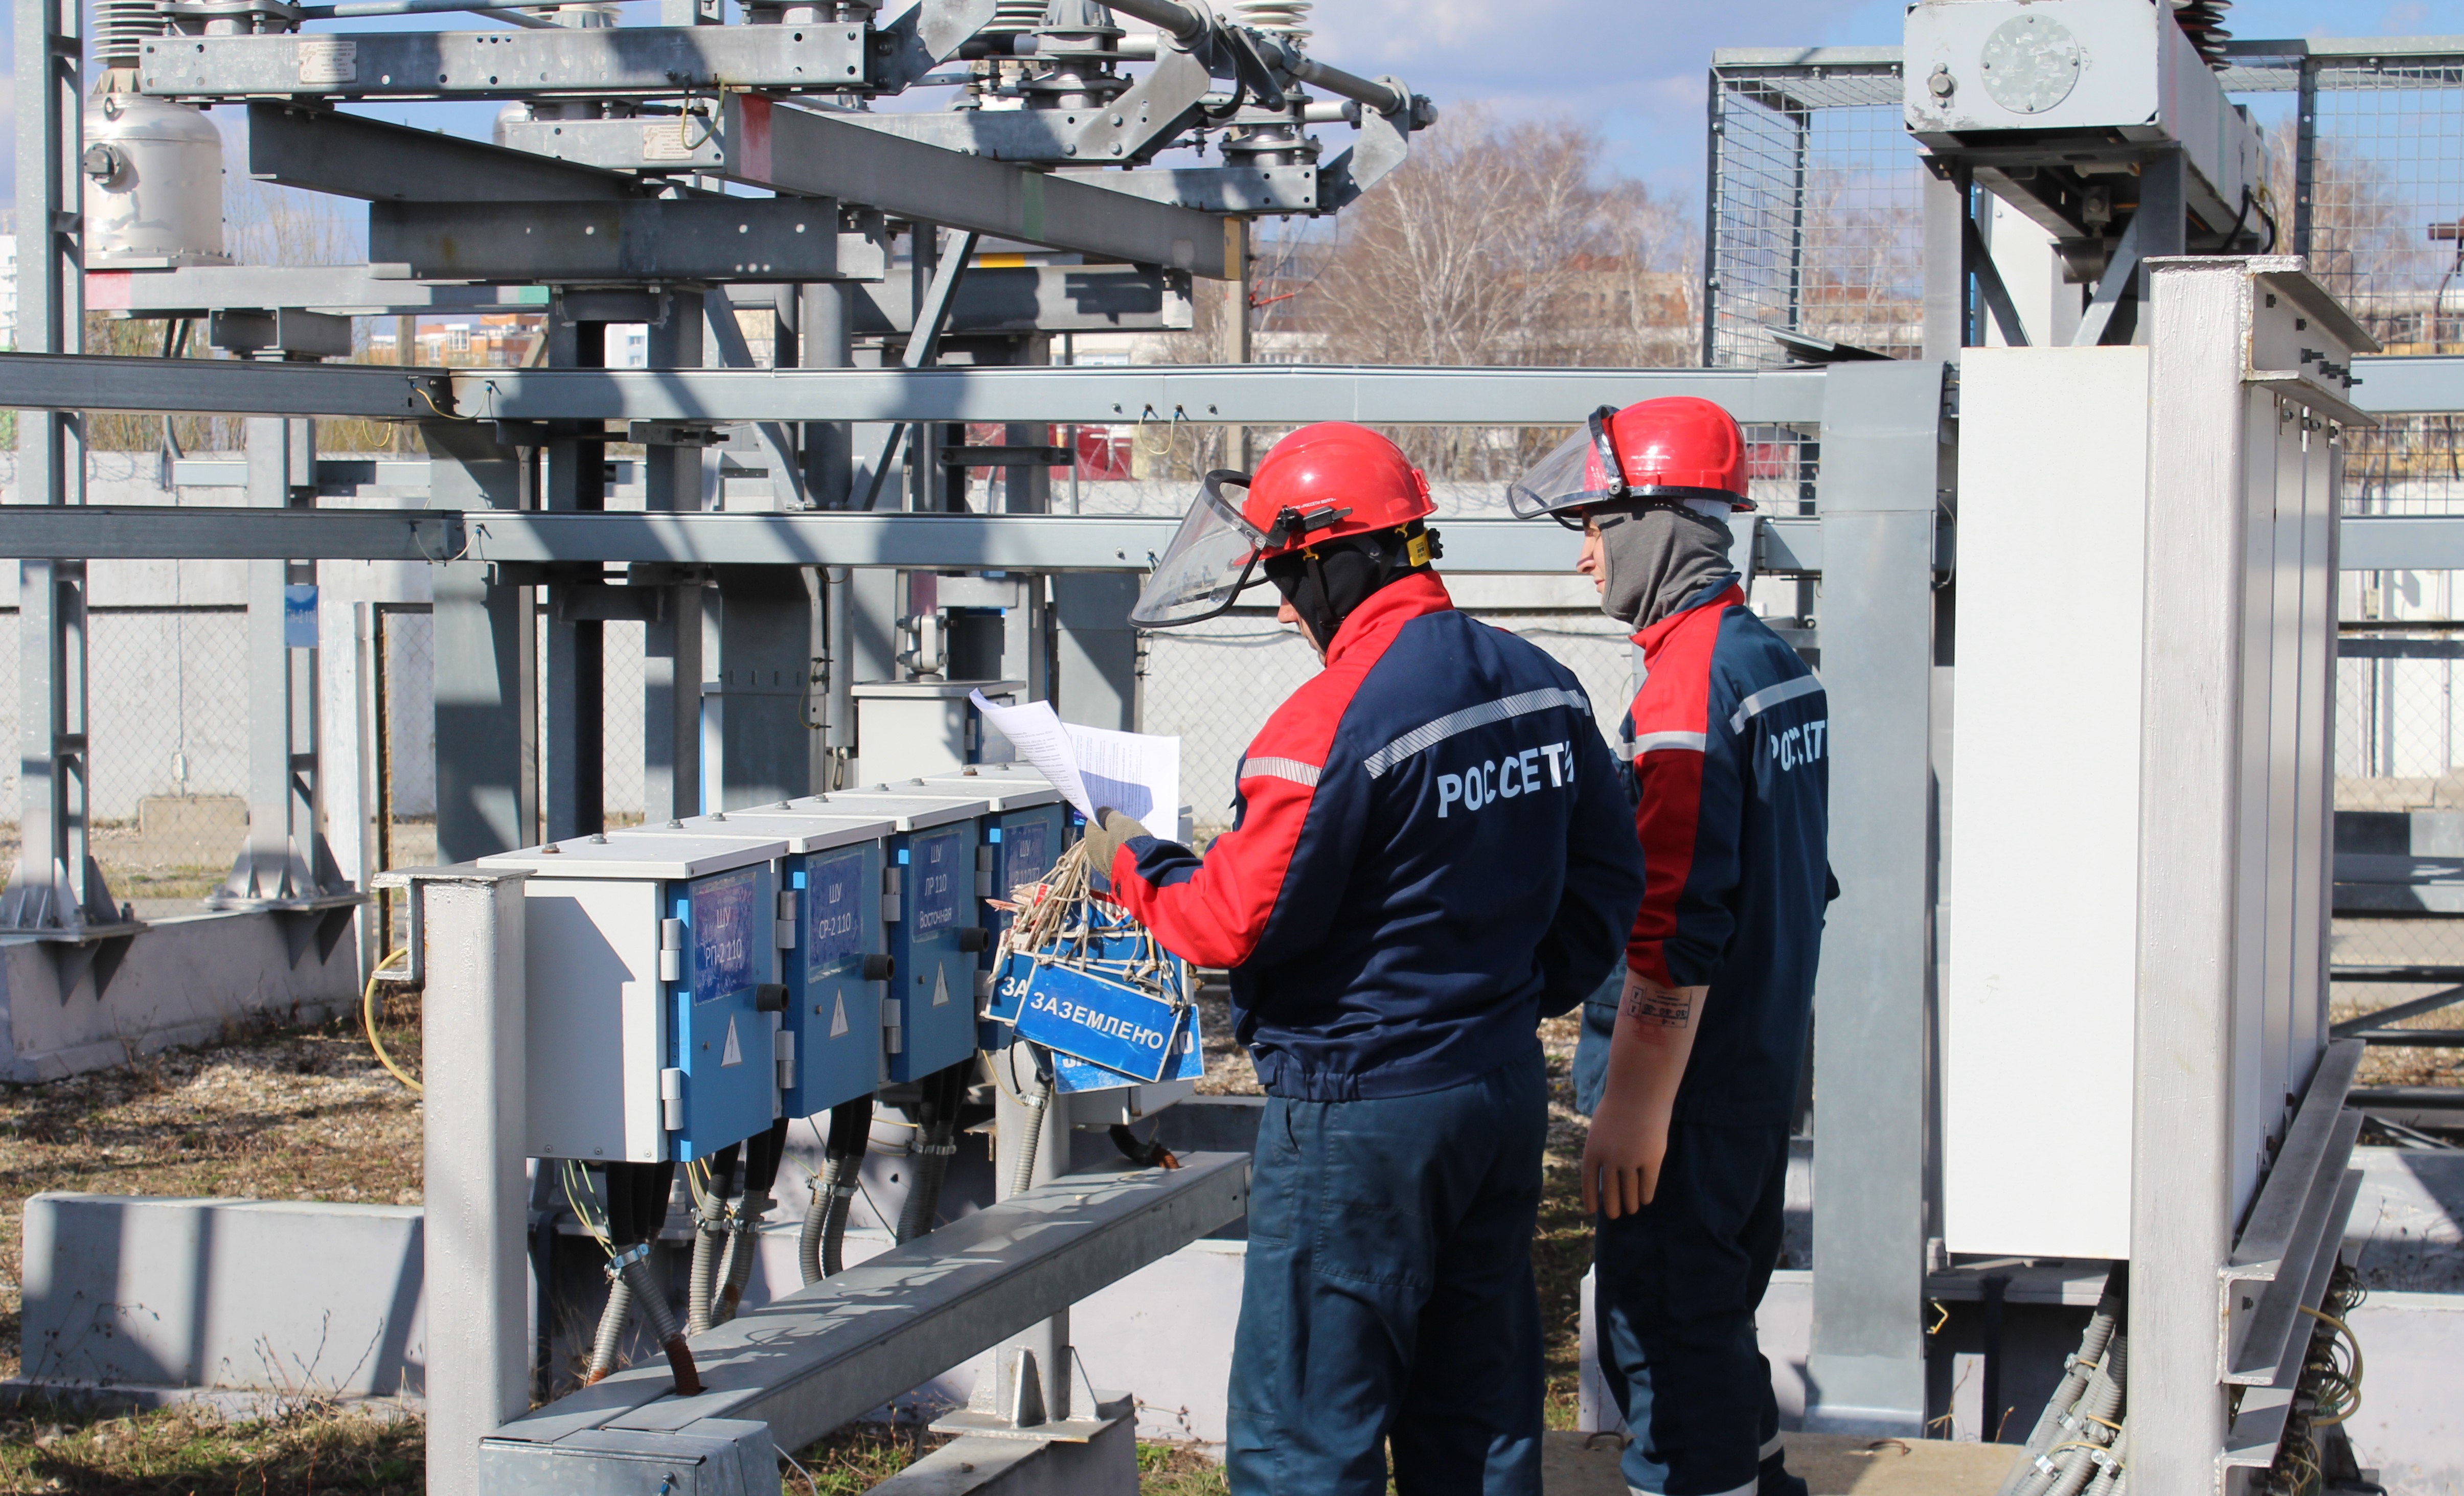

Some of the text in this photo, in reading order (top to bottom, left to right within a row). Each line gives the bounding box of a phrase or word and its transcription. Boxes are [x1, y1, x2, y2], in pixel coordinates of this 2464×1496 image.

[930, 844, 942, 864] ШУ
[1020, 839, 1031, 857] ШУ
[829, 882, 842, 904] ШУ
[925, 873, 947, 896] ЛР 110
[717, 906, 731, 929] ШУ
[819, 912, 851, 939] СР-2 110
[920, 907, 952, 929] Восточная
[705, 938, 742, 967] РП-2 110
[1030, 992, 1164, 1050] ЗАЗЕМЛЕНО
